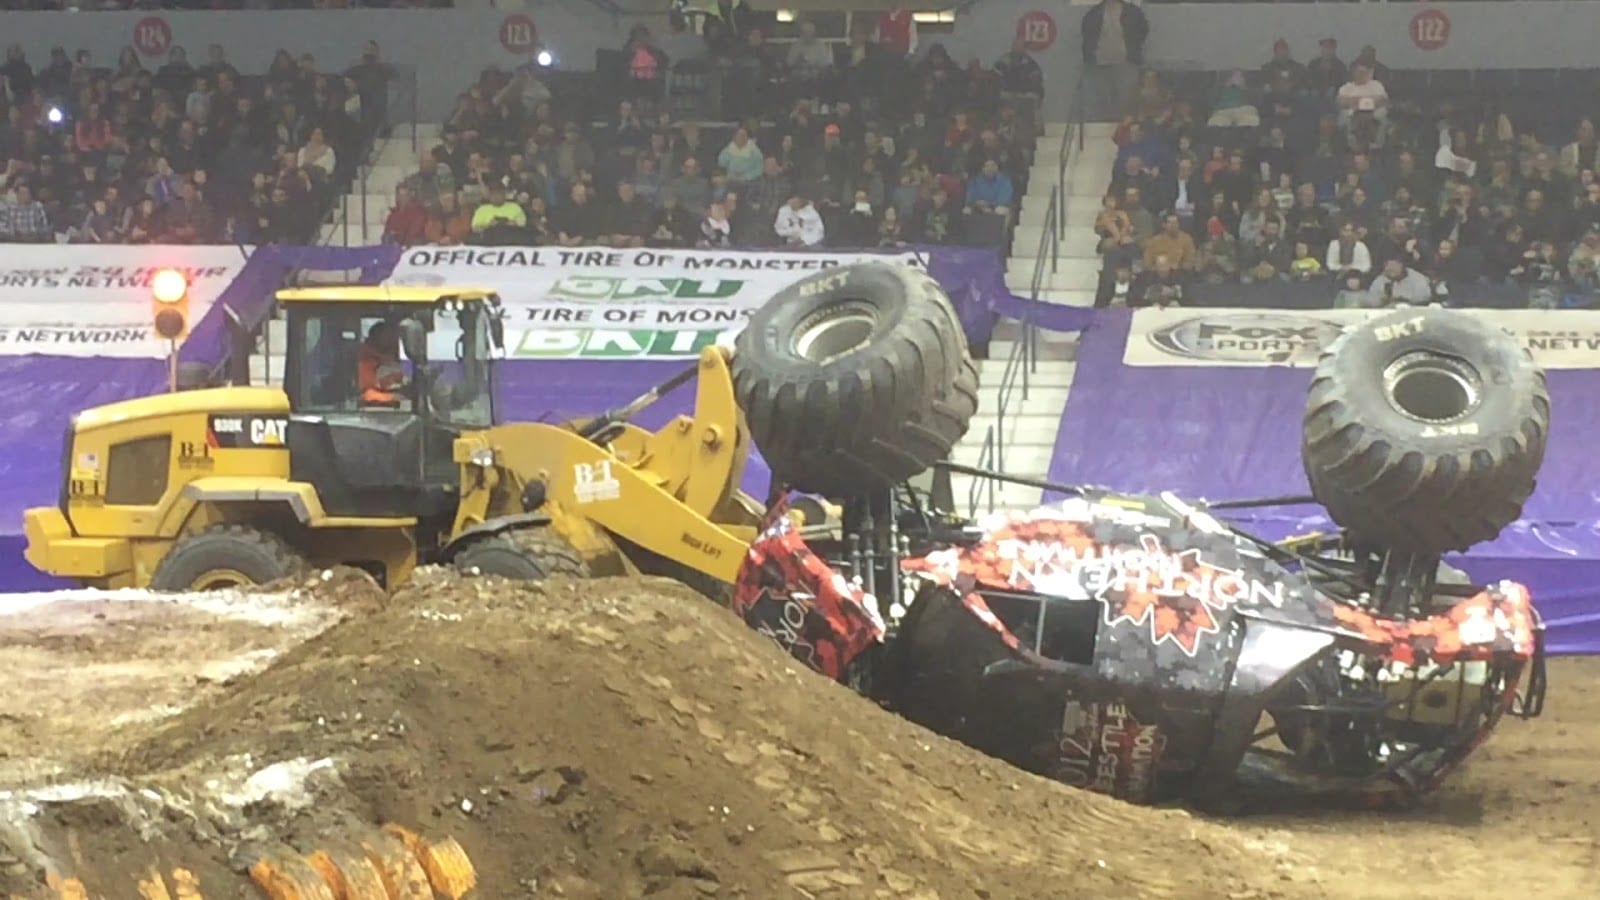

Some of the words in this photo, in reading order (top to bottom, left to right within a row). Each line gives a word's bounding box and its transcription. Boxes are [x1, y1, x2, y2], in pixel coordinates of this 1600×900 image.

[141, 27, 166, 47] 124
[507, 24, 531, 45] 123
[1025, 20, 1049, 41] 123
[1418, 19, 1445, 40] 122
[408, 250, 546, 266] OFFICIAL
[558, 251, 623, 266] TIRE
[633, 251, 674, 266] OF
[800, 271, 849, 296] BKT
[526, 308, 593, 322] TIRE
[603, 309, 647, 323] OF
[16, 329, 148, 342] NETWORK
[1374, 316, 1425, 341] BKT
[250, 418, 288, 445] CAT
[1009, 558, 1284, 608] NORTHERN
